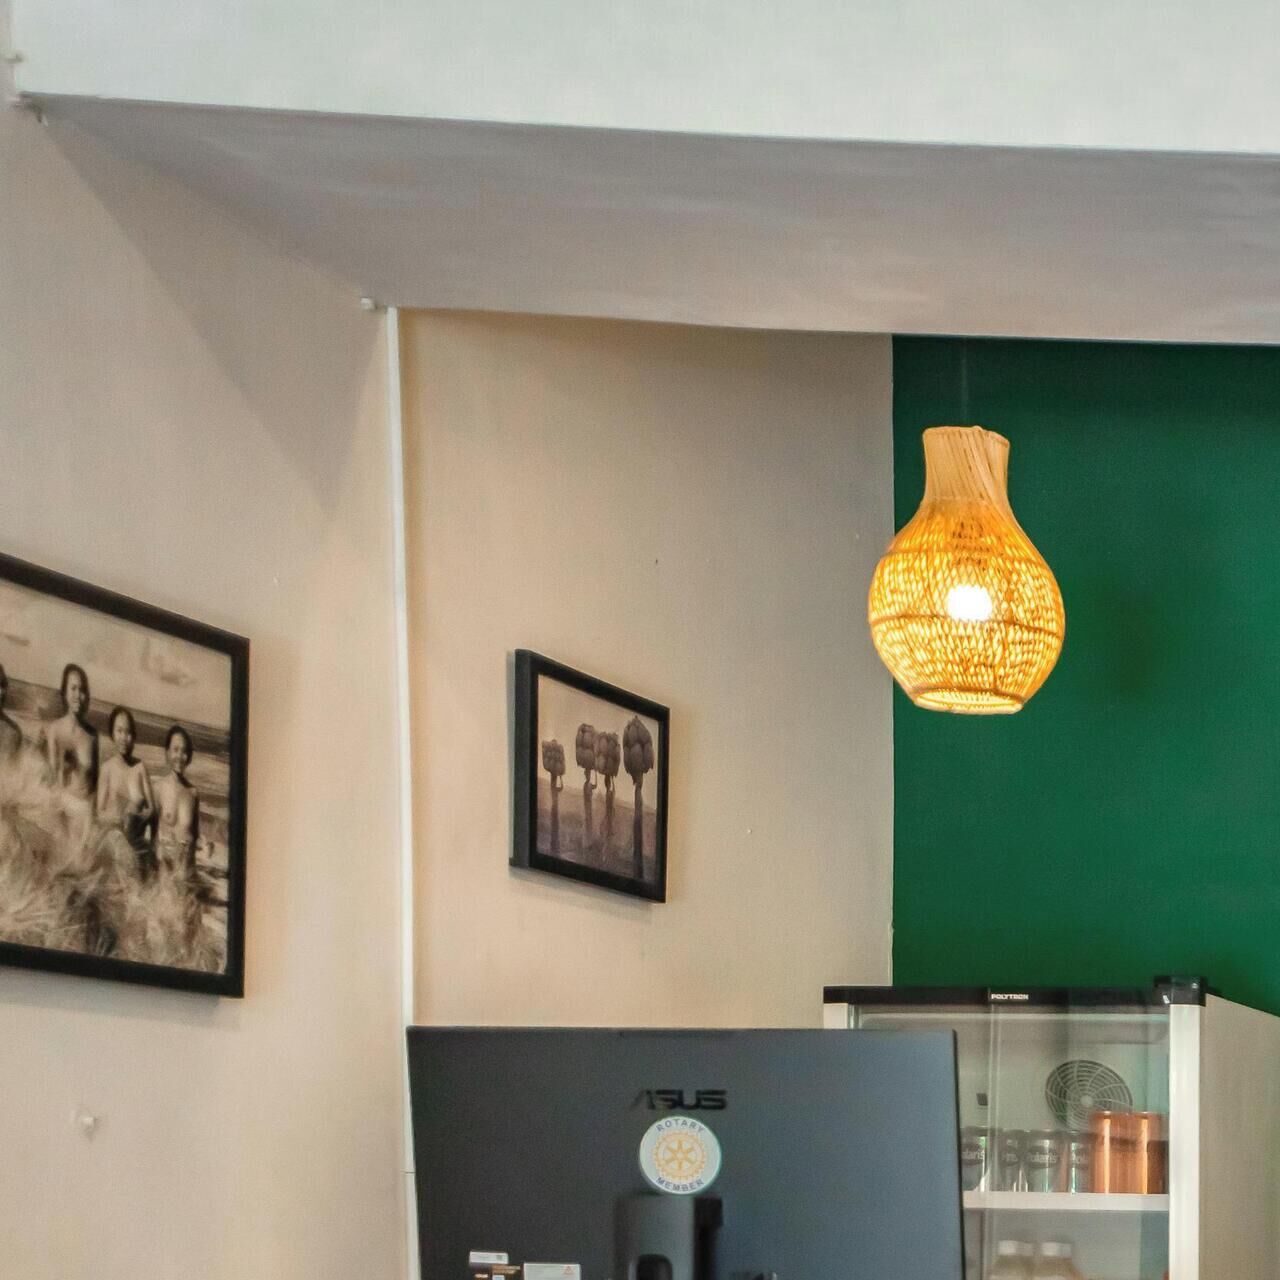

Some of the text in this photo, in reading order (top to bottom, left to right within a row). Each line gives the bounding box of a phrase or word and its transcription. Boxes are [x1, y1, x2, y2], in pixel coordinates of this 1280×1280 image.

[629, 1089, 727, 1110] ASUS
[656, 1119, 704, 1132] ROTARY
[656, 1177, 704, 1192] MEMBER
